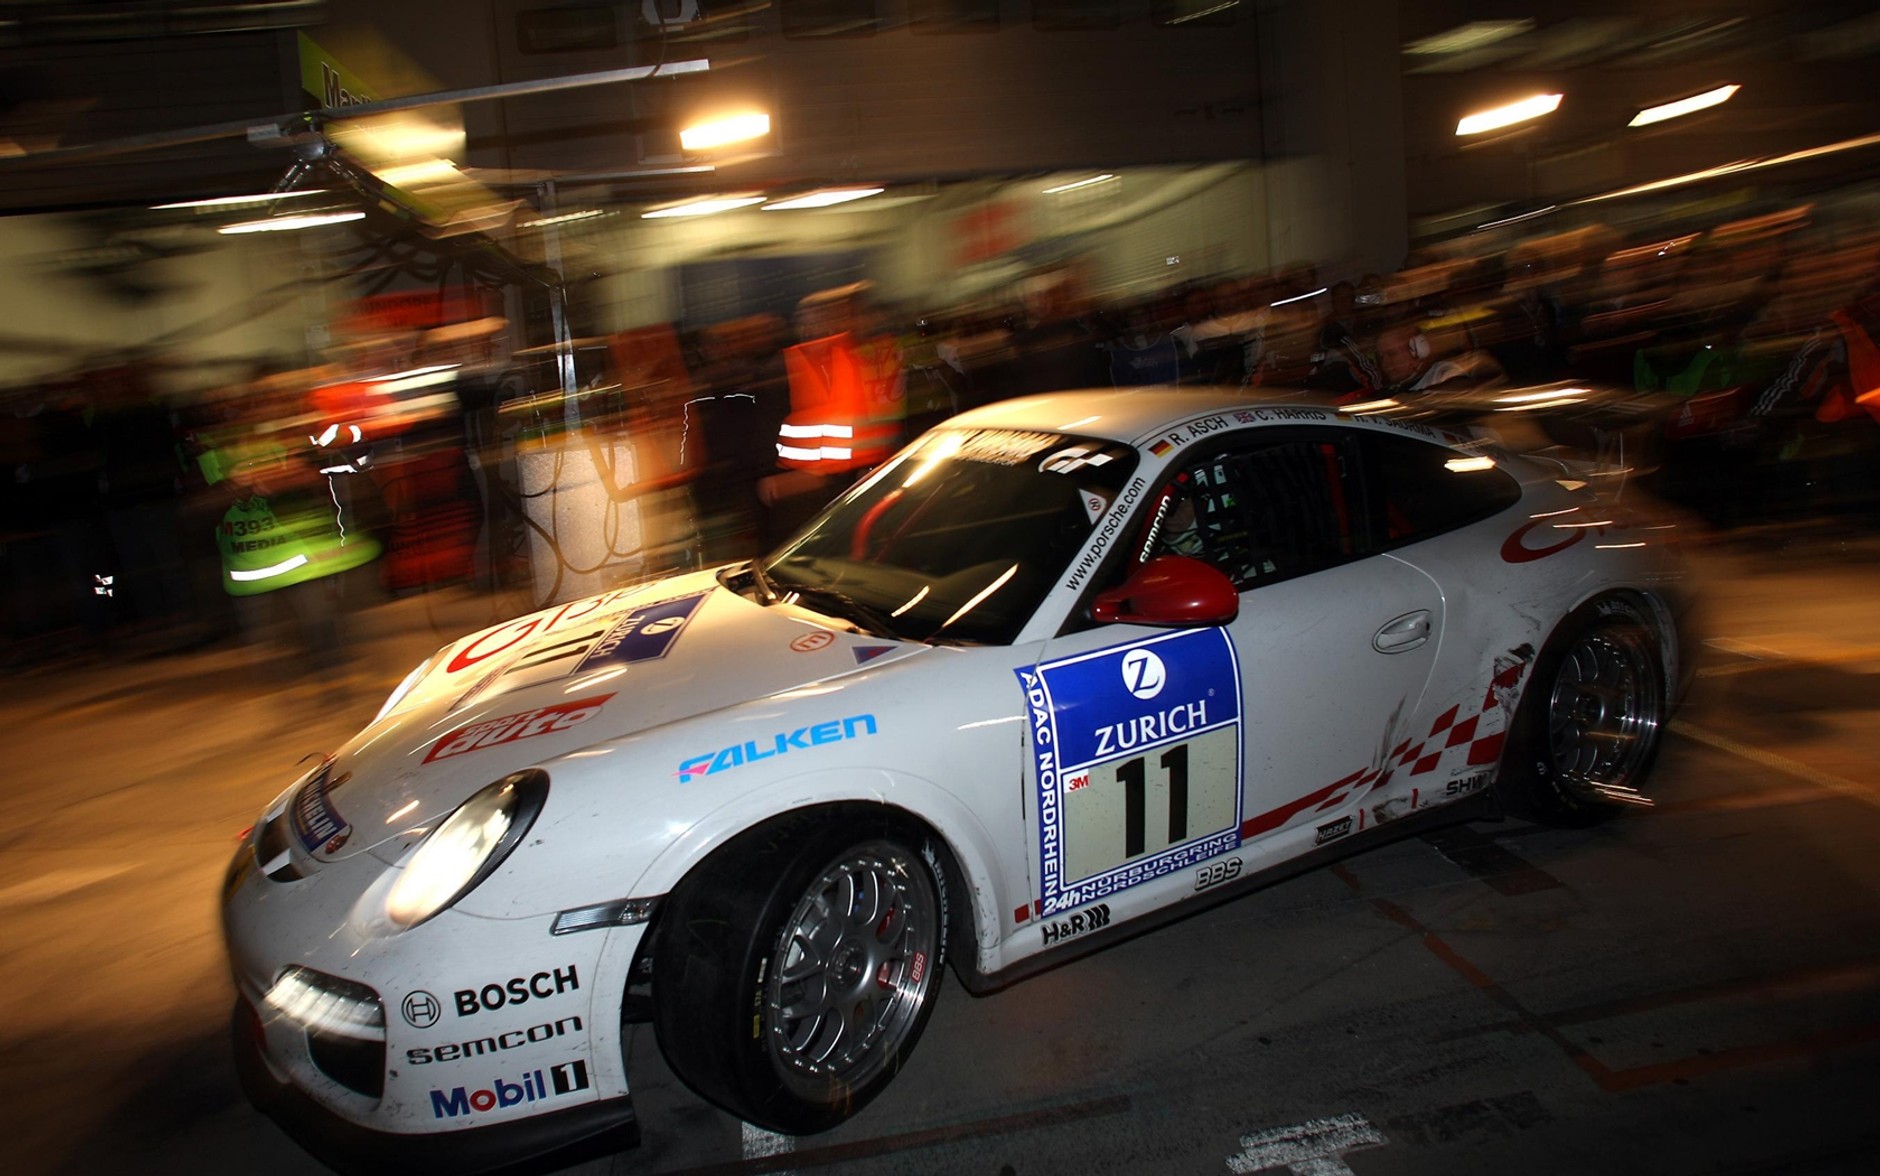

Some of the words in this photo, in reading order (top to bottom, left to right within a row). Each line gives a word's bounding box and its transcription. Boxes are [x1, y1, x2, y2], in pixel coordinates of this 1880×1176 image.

[1168, 432, 1189, 446] R.
[1187, 415, 1229, 438] ASCH
[1255, 410, 1274, 421] C.
[1066, 477, 1146, 591] www.porsche.com
[433, 706, 603, 759] auto
[675, 713, 878, 783] FALKEN
[1094, 699, 1207, 756] ZURICH
[1020, 671, 1051, 746] ADAC
[1039, 751, 1059, 897] NORDRHEIN
[1068, 774, 1089, 791] 3M
[1116, 743, 1189, 859] 11
[1194, 856, 1243, 892] BBS
[1044, 889, 1081, 914] 24h
[1041, 914, 1085, 946] H&R
[453, 964, 579, 1018] BOSCH
[911, 952, 925, 981] BBS
[405, 1015, 583, 1065] semcon
[429, 1069, 547, 1119] Mobil
[557, 1061, 582, 1094] 1
